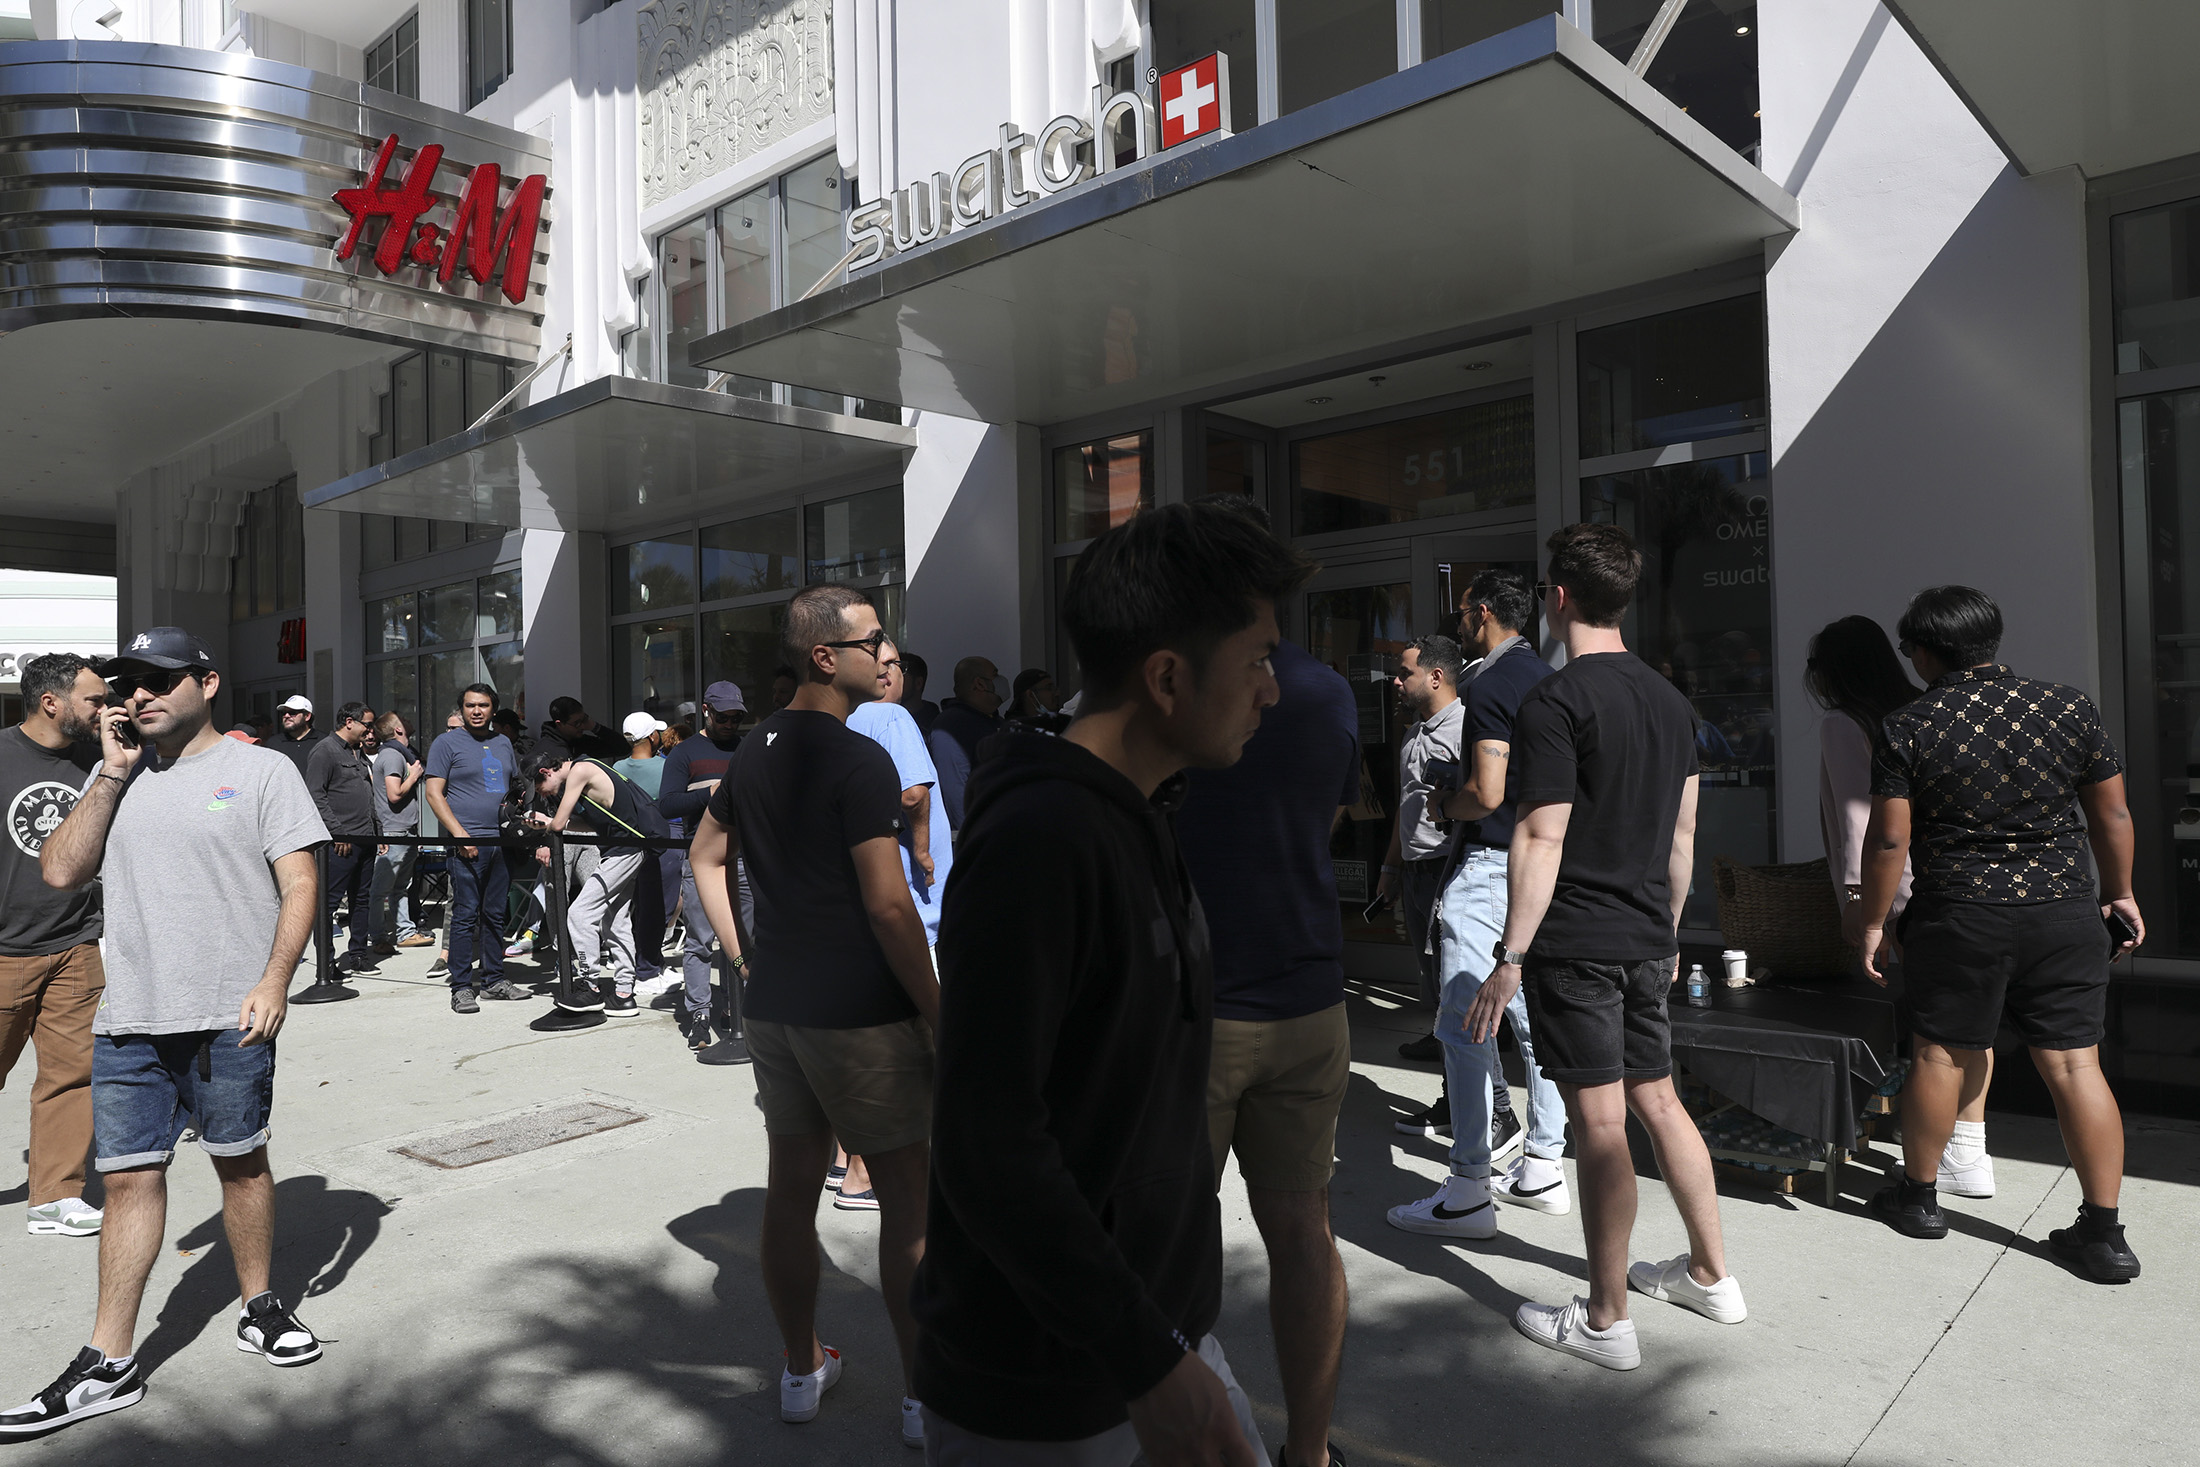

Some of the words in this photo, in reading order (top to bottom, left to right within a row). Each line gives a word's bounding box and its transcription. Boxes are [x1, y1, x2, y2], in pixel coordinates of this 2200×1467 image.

[845, 83, 1150, 273] swatch
[331, 133, 547, 305] H&M
[1402, 446, 1463, 486] 551
[1703, 564, 1770, 587] swat
[131, 633, 152, 651] LA
[1334, 867, 1365, 877] ILLEGAL
